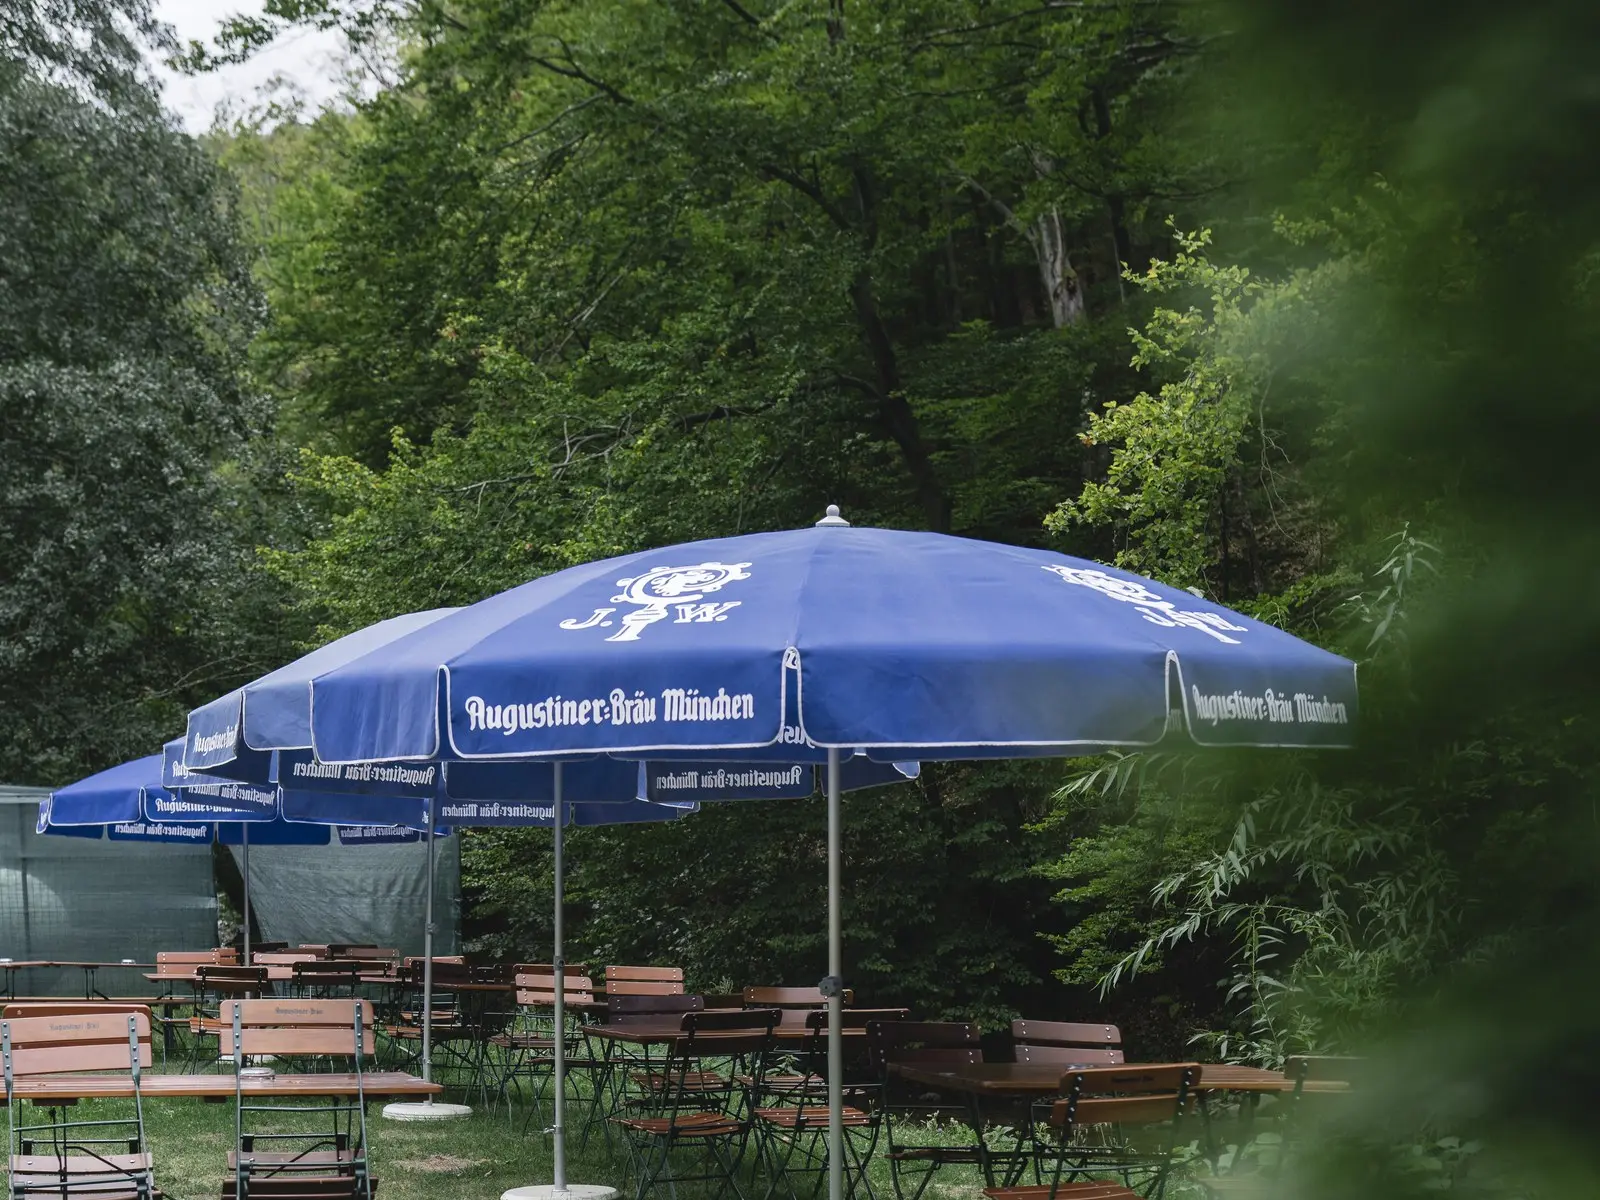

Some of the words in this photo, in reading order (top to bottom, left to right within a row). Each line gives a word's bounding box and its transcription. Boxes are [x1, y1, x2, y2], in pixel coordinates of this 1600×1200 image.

[465, 688, 656, 735] Augustiner-Bräu
[661, 687, 754, 722] München
[1294, 693, 1348, 724] München
